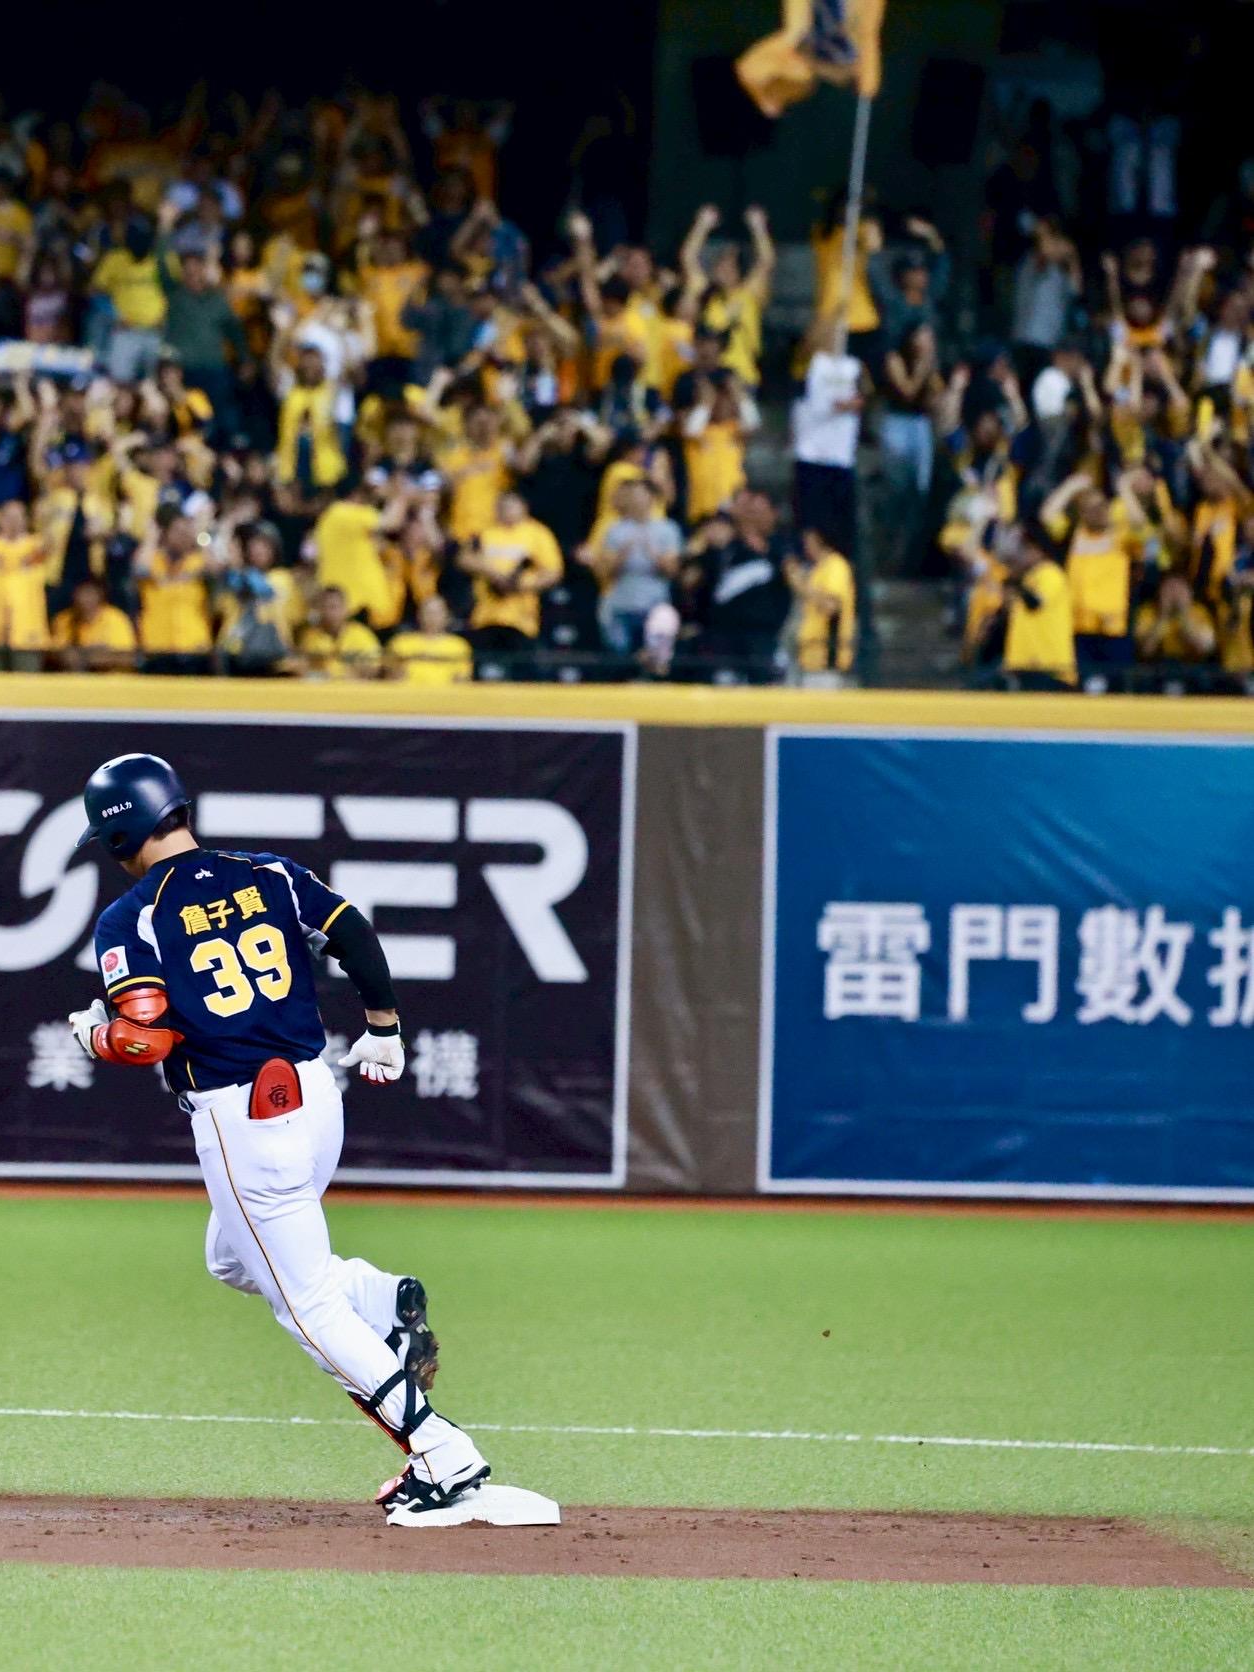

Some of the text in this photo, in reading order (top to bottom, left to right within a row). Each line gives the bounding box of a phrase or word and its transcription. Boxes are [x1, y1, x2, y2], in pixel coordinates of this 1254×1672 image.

[179, 885, 268, 936] 詹子賢
[189, 922, 293, 1019] 39
